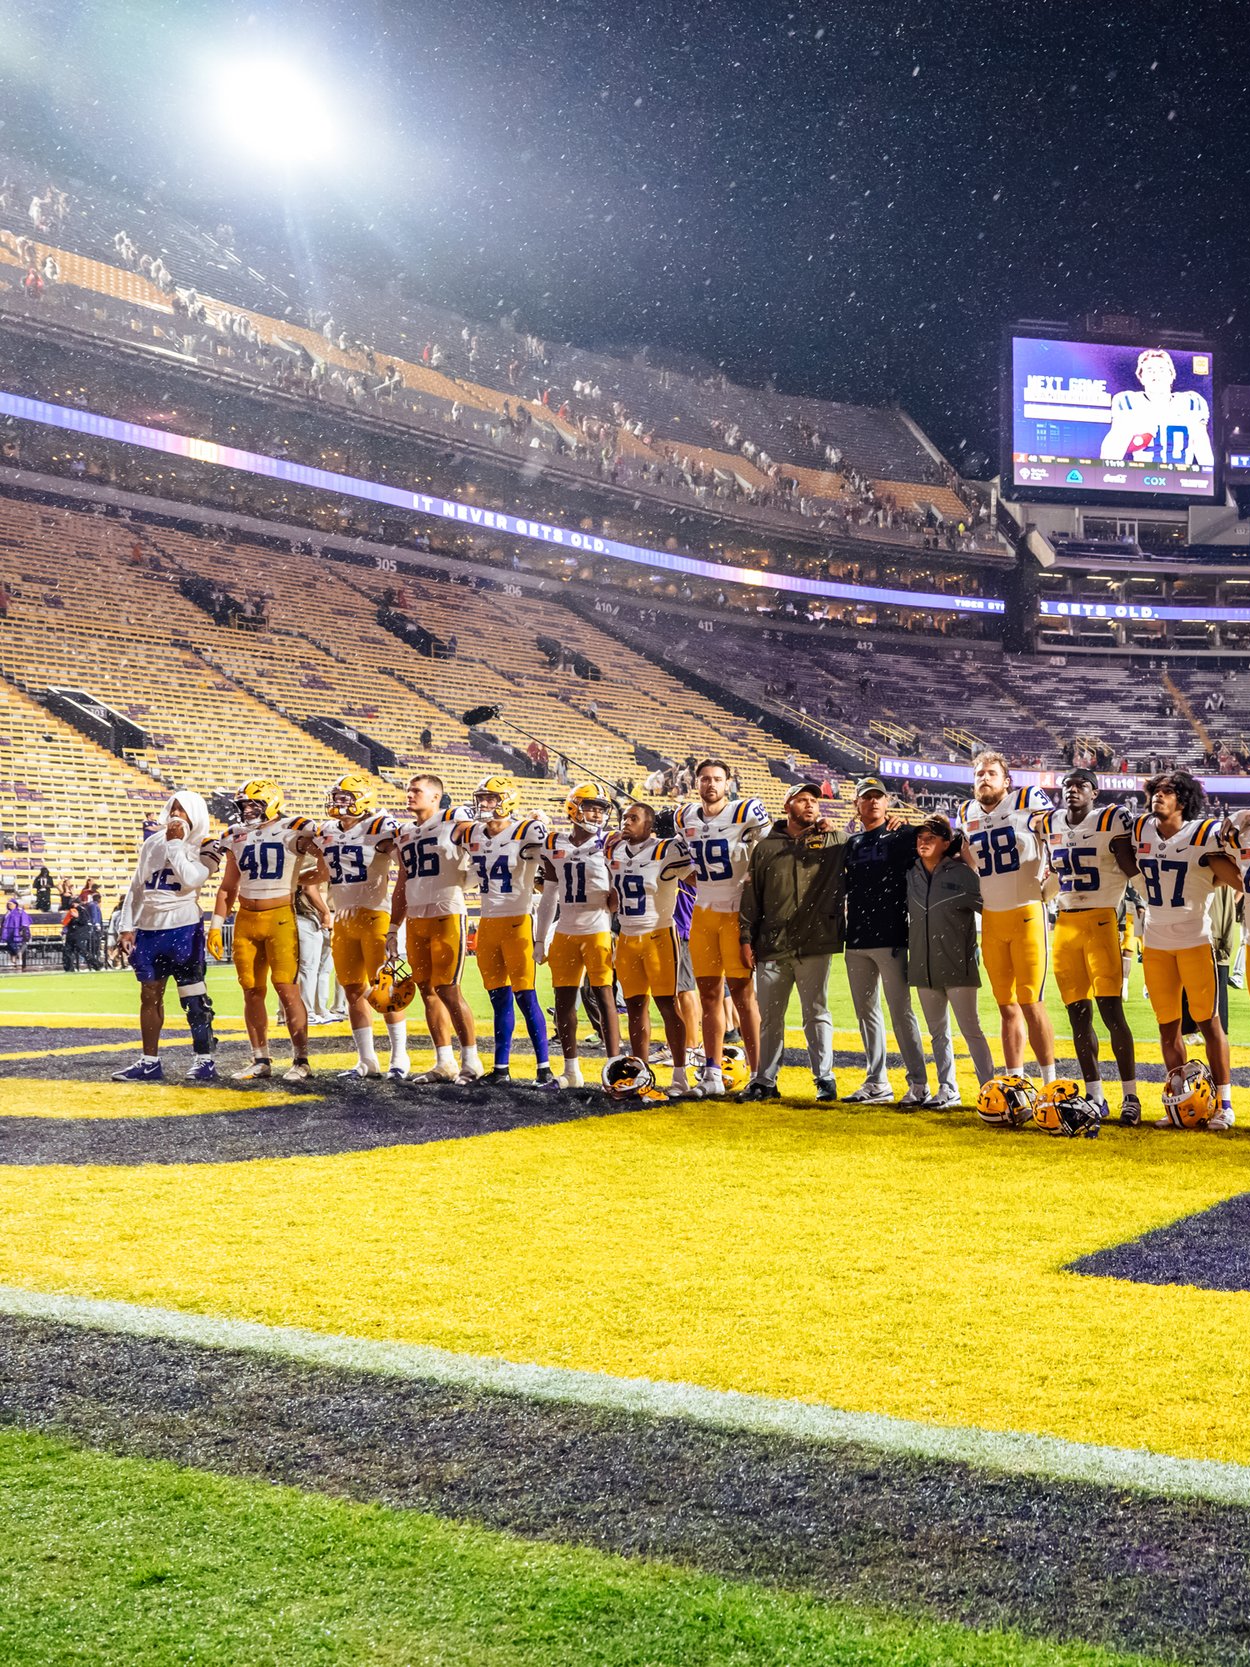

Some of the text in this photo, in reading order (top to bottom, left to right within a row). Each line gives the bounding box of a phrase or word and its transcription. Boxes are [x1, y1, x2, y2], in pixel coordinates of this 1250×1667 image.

[1027, 375, 1063, 391] NEXT
[1143, 476, 1167, 486] COX
[412, 495, 610, 554] IT NEVER GETS OLD.
[375, 558, 397, 573] 305
[502, 583, 523, 598] 306
[595, 600, 612, 613] 410
[954, 599, 984, 609] TIGER
[1057, 603, 1107, 617] GETS
[1115, 606, 1159, 618] OLD.
[698, 620, 714, 632] 411
[914, 764, 942, 779] OLD.
[1105, 778, 1134, 789] 11:10
[970, 825, 1021, 877] 38
[238, 842, 285, 880] 40
[324, 845, 368, 884] 33
[690, 838, 733, 882] 99
[1052, 847, 1101, 892] 25
[564, 862, 587, 904] 11
[1138, 858, 1188, 908] 87
[614, 874, 647, 916] 19
